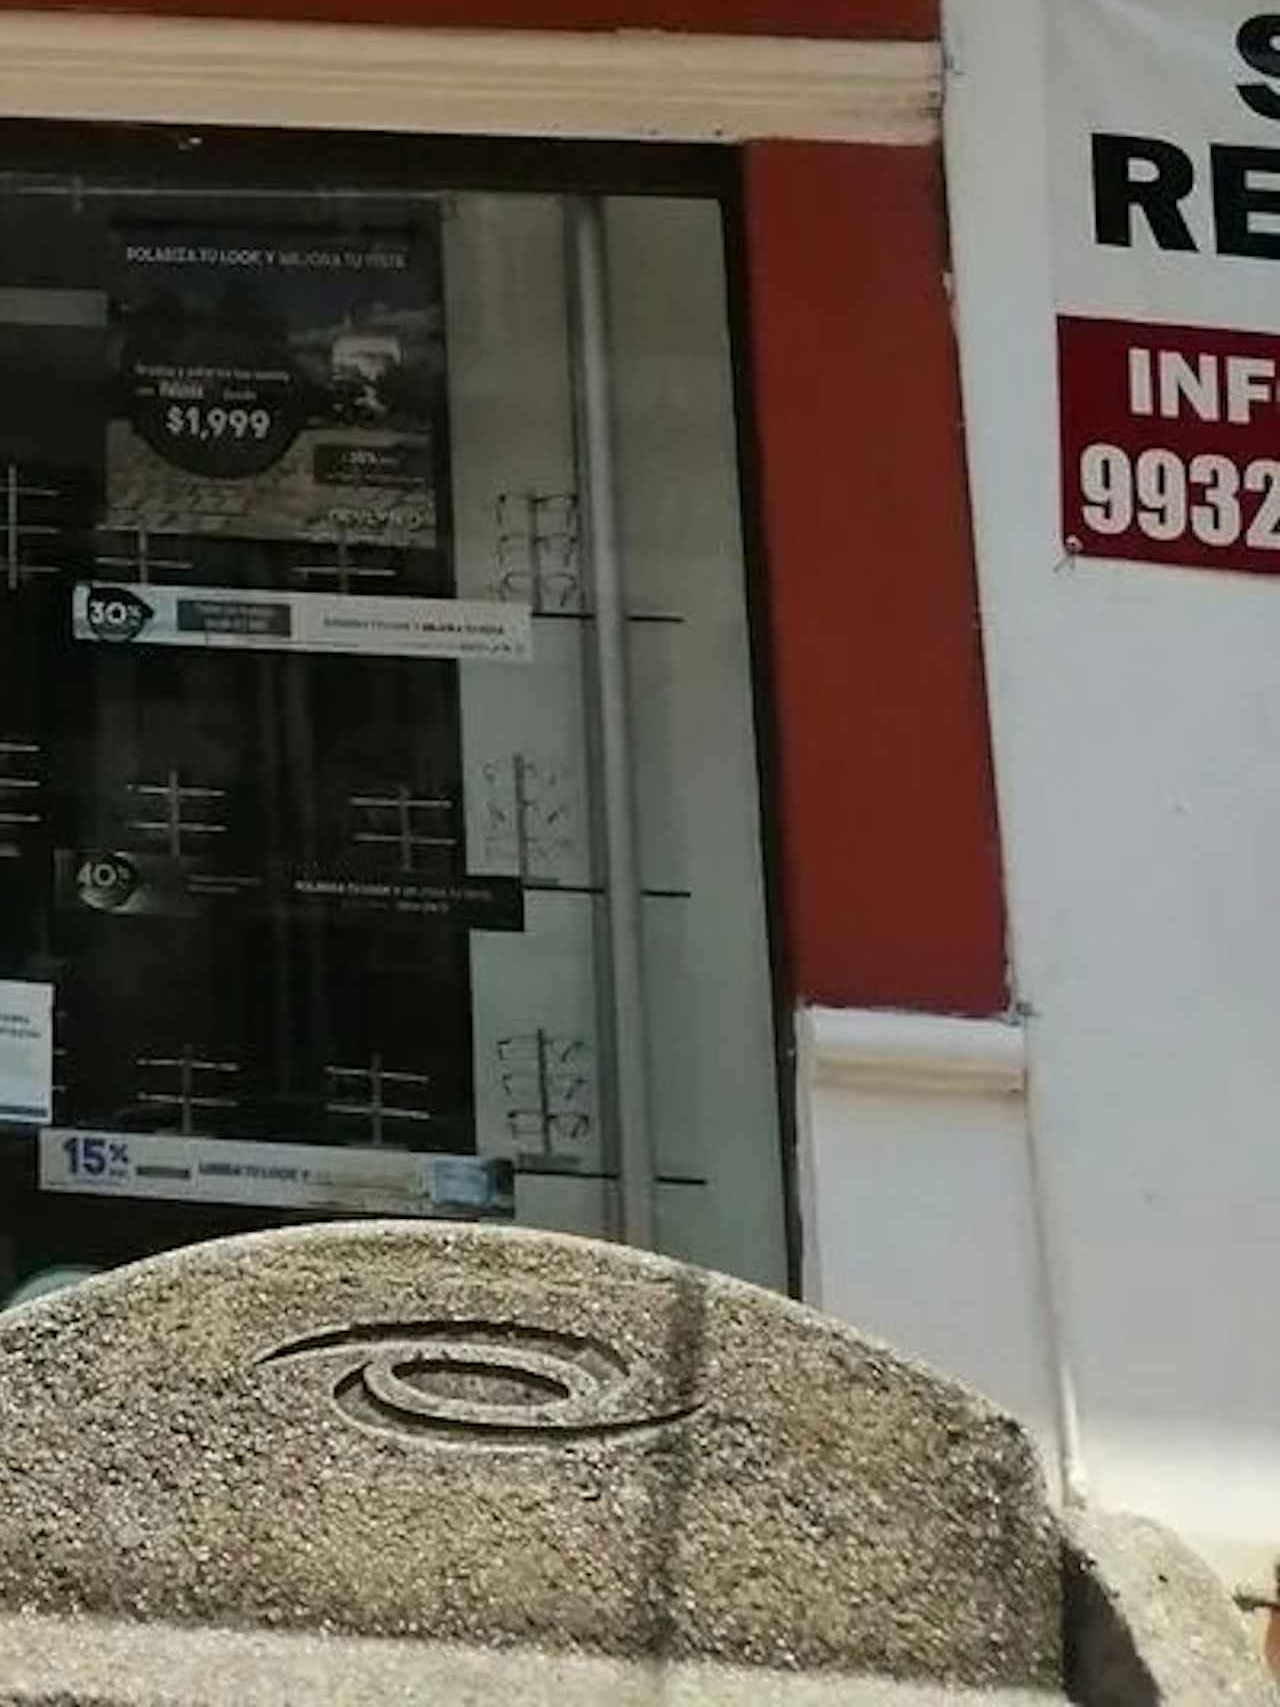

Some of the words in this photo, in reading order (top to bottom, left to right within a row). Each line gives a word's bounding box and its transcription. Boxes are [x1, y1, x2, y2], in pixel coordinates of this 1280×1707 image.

[1128, 347, 1280, 425] INF
[165, 405, 271, 441] $1,999
[89, 600, 142, 626] 30%
[61, 1137, 129, 1176] 15%
